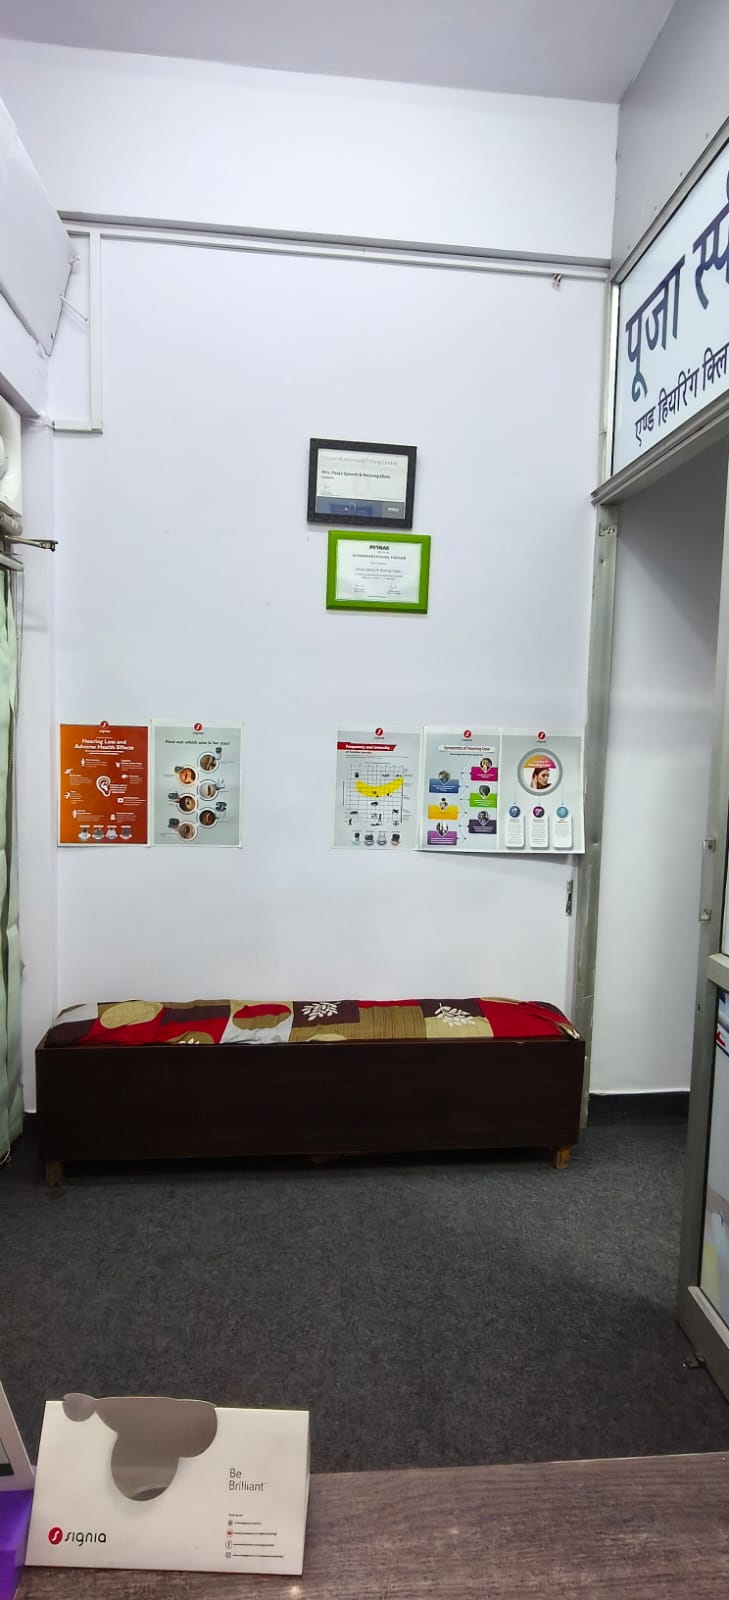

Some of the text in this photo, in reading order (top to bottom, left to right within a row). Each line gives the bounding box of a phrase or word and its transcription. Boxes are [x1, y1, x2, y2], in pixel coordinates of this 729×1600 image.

[625, 253, 685, 402] पूजा
[635, 405, 656, 447] एण्ड
[658, 368, 699, 427] हियरिंग
[229, 1467, 242, 1479] Be
[228, 1479, 264, 1492] Brilliant
[64, 1531, 107, 1547] signia
